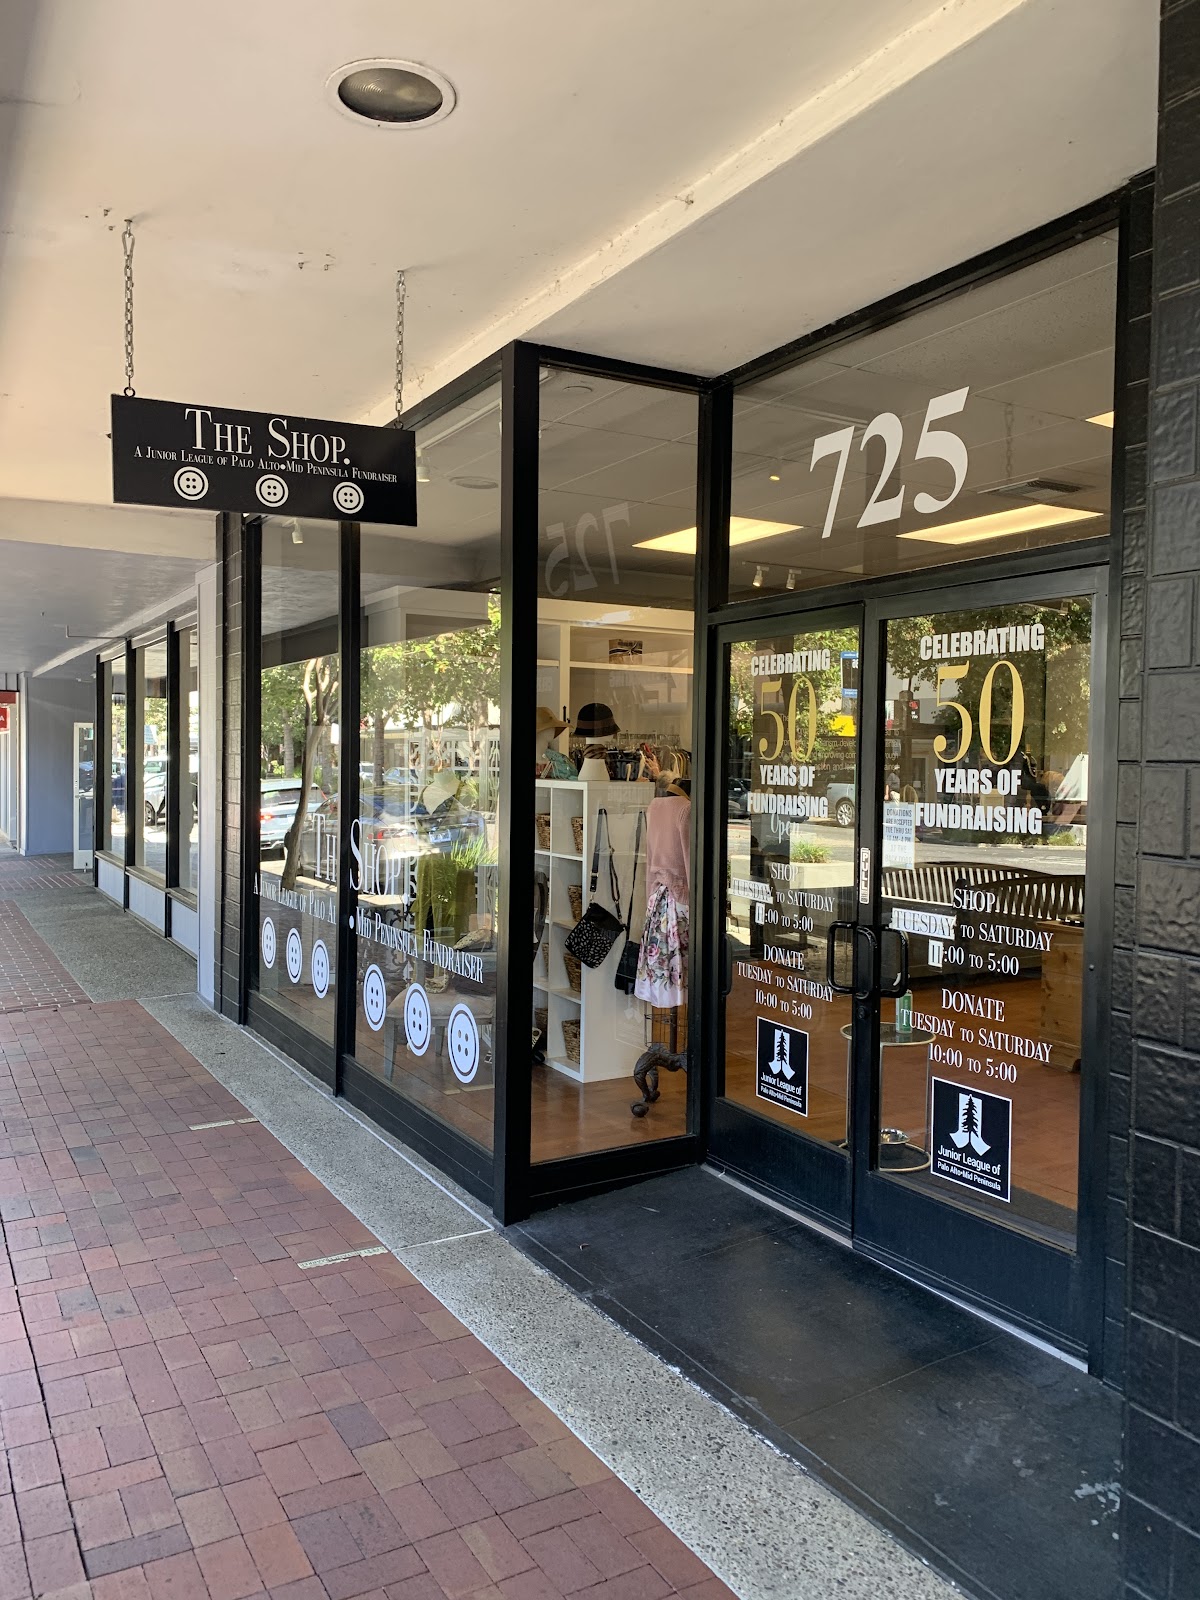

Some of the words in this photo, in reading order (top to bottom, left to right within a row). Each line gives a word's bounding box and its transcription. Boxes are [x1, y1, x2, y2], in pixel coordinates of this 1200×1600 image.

[184, 408, 253, 455] THE
[267, 418, 350, 465] SHOP.
[134, 446, 143, 457] A
[146, 446, 177, 460] JUNIOR
[181, 450, 214, 465] LEAGUE
[231, 455, 254, 468] PALO
[307, 462, 349, 477] PENINSULA
[352, 467, 397, 482] FUNDRAISER
[809, 386, 970, 539] 725
[920, 623, 1045, 661] CELEBRATING
[751, 649, 830, 677] CELEBRATING
[759, 677, 817, 762] 50
[933, 660, 1025, 766] 50
[759, 764, 797, 787] YEARS
[799, 766, 816, 788] OF
[934, 768, 992, 796] YEARS
[997, 768, 1022, 796] OF
[747, 792, 829, 818] FUNDRAISING
[915, 802, 1043, 835] FUNDRAISING
[770, 862, 799, 882] SHOP
[861, 852, 869, 890] PULL
[787, 890, 835, 913] SATURDAY
[953, 887, 996, 914] SHOP
[793, 914, 814, 933] 5:00
[894, 908, 956, 938] TUESDAY
[979, 922, 1054, 952] SATURDAY
[374, 912, 419, 959] PENINSULA
[422, 928, 484, 984] FUNDRAISER
[763, 943, 805, 971] DONATE
[988, 952, 1020, 976] 5:00
[737, 961, 773, 985] TUESDAY
[787, 975, 834, 1003] SATURDAY
[755, 988, 778, 1009] 10:00
[792, 1000, 812, 1020] 5:00
[941, 988, 1005, 1023] DONATE
[900, 1008, 956, 1039] TUESDAY
[978, 1027, 1053, 1063] SATURDAY
[928, 1042, 963, 1069] 10:00
[985, 1058, 1017, 1084] 5:00
[761, 1072, 776, 1086] Junior
[776, 1078, 796, 1093] League
[796, 1085, 802, 1096] of
[937, 1144, 962, 1162] Junior
[962, 1152, 991, 1172] League
[991, 1164, 1001, 1175] of
[937, 1160, 950, 1172] Palo
[973, 1174, 1001, 1191] Peninsula
